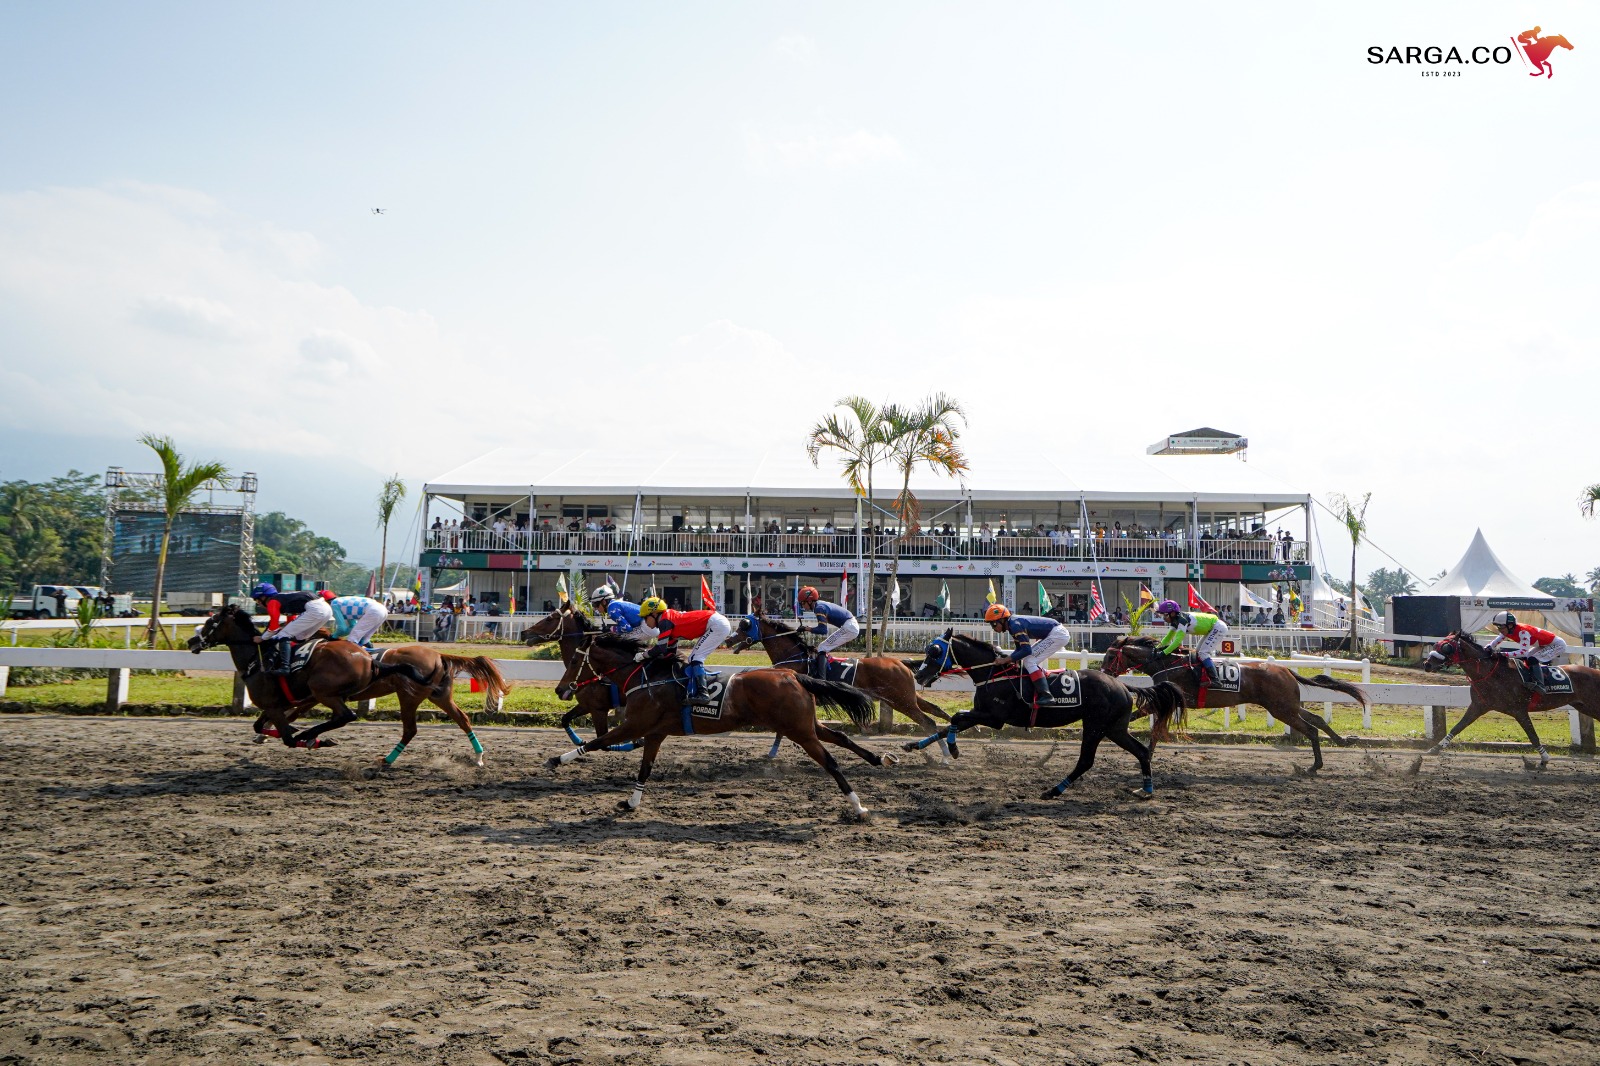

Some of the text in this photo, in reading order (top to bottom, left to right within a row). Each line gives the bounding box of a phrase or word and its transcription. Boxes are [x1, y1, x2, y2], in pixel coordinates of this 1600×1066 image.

[295, 642, 312, 658] 4
[1224, 642, 1232, 652] 3
[840, 662, 854, 680] 7
[1218, 665, 1239, 682] 10
[1548, 667, 1566, 681] 8
[1060, 674, 1076, 695] 9
[707, 681, 723, 706] 2
[692, 705, 718, 716] PORDASI
